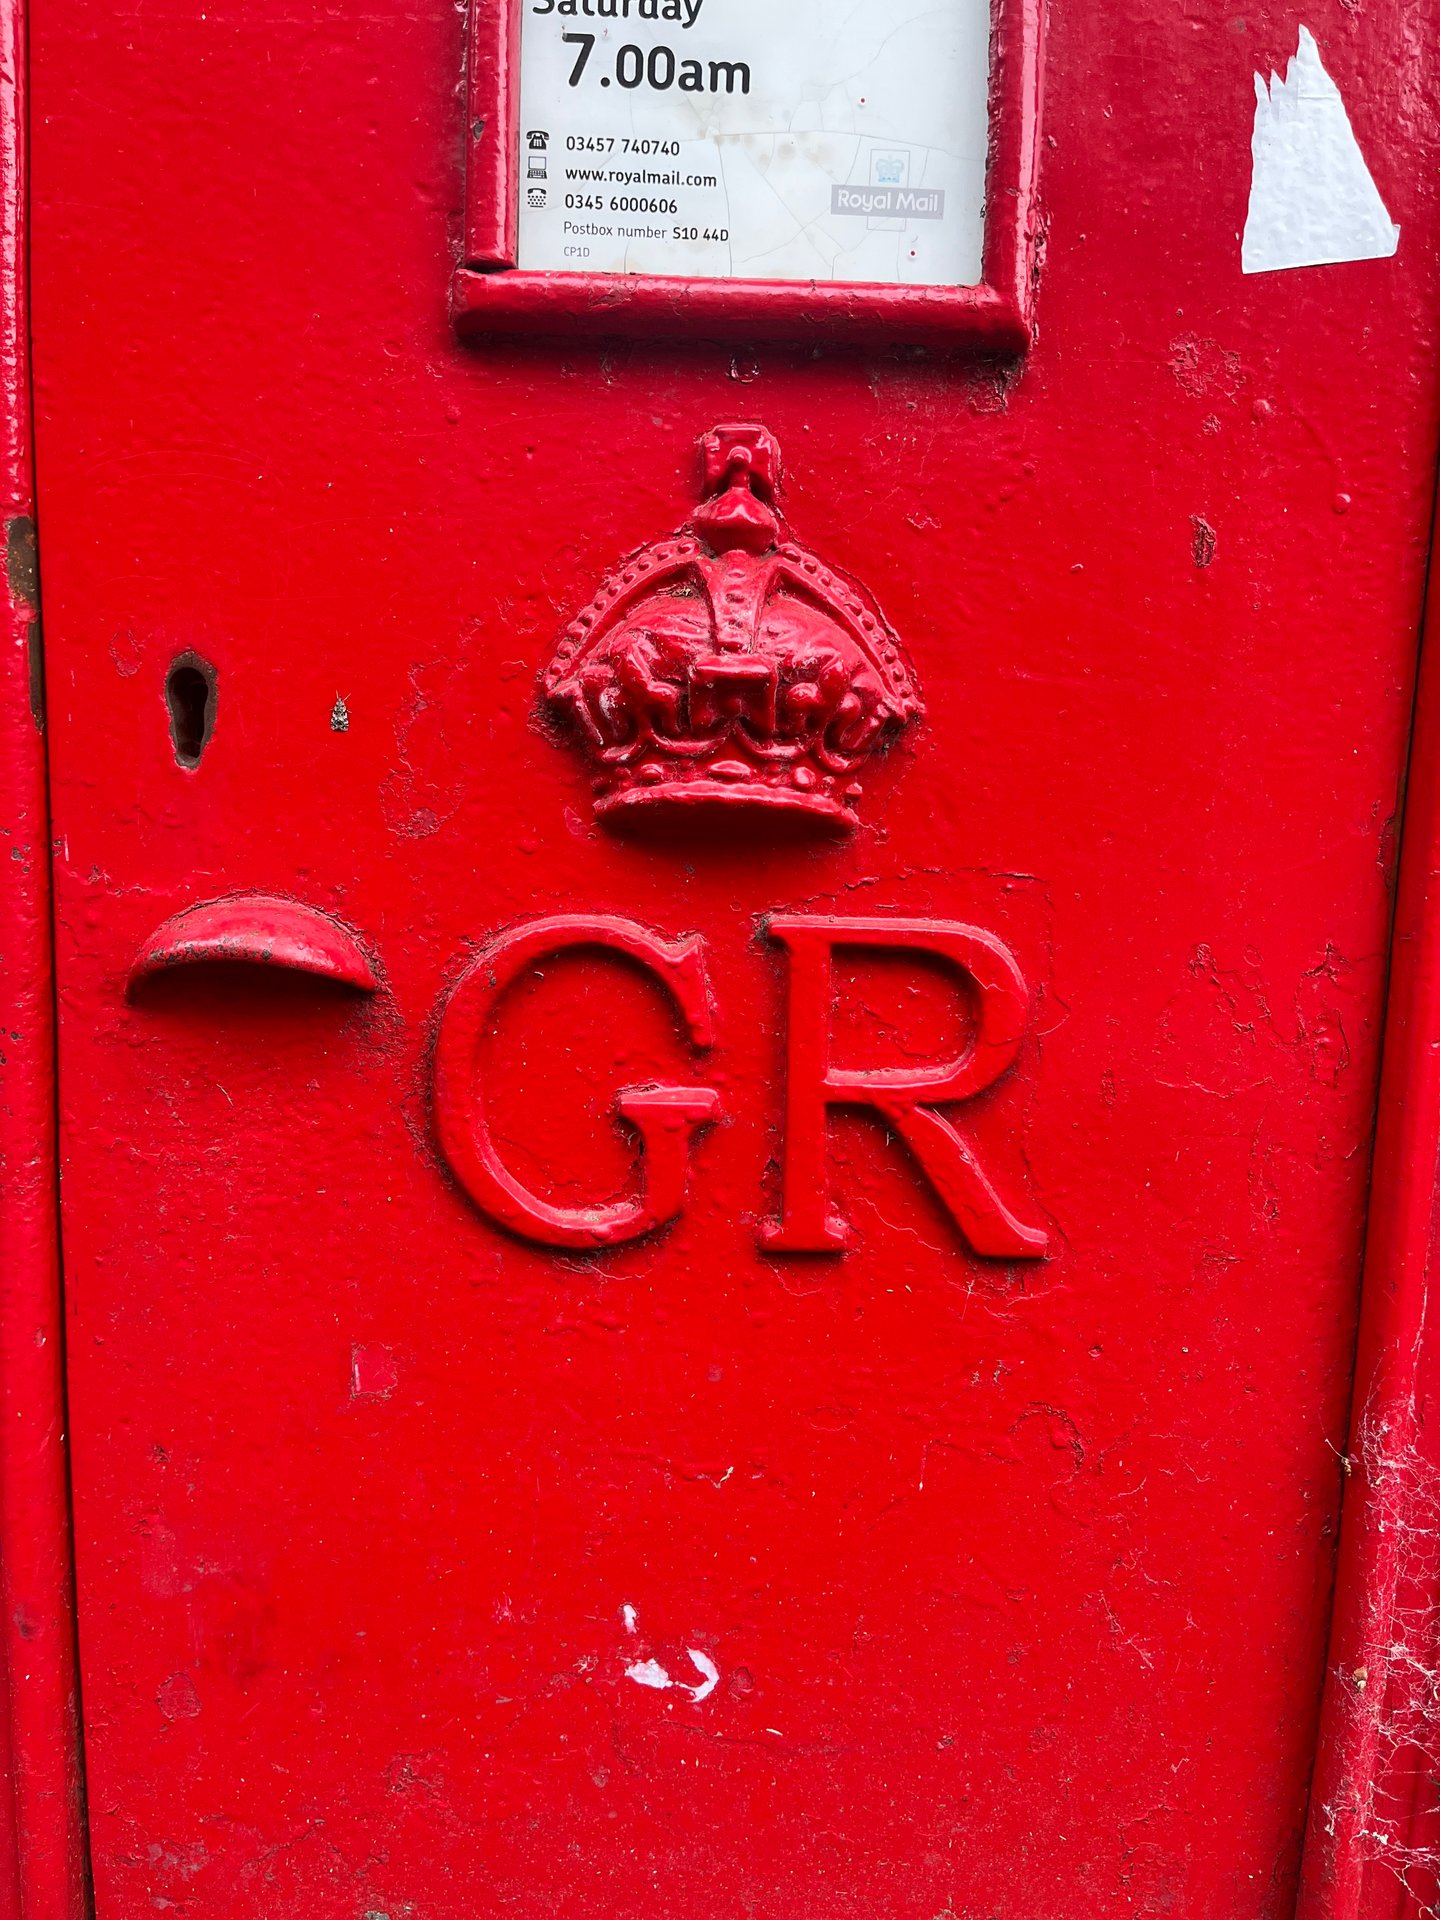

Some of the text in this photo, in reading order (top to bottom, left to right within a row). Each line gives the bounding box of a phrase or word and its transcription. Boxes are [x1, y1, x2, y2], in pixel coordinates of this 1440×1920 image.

[561, 32, 751, 95] 7.00am
[566, 136, 680, 156] 03457 740740
[565, 168, 717, 187] www.royalmail.com
[564, 194, 678, 214] 0345 6000606
[837, 189, 938, 213] Royal Mail
[563, 221, 729, 241] Postbox number S10 44D
[563, 246, 590, 257] CP1D
[433, 913, 1050, 1258] GR
